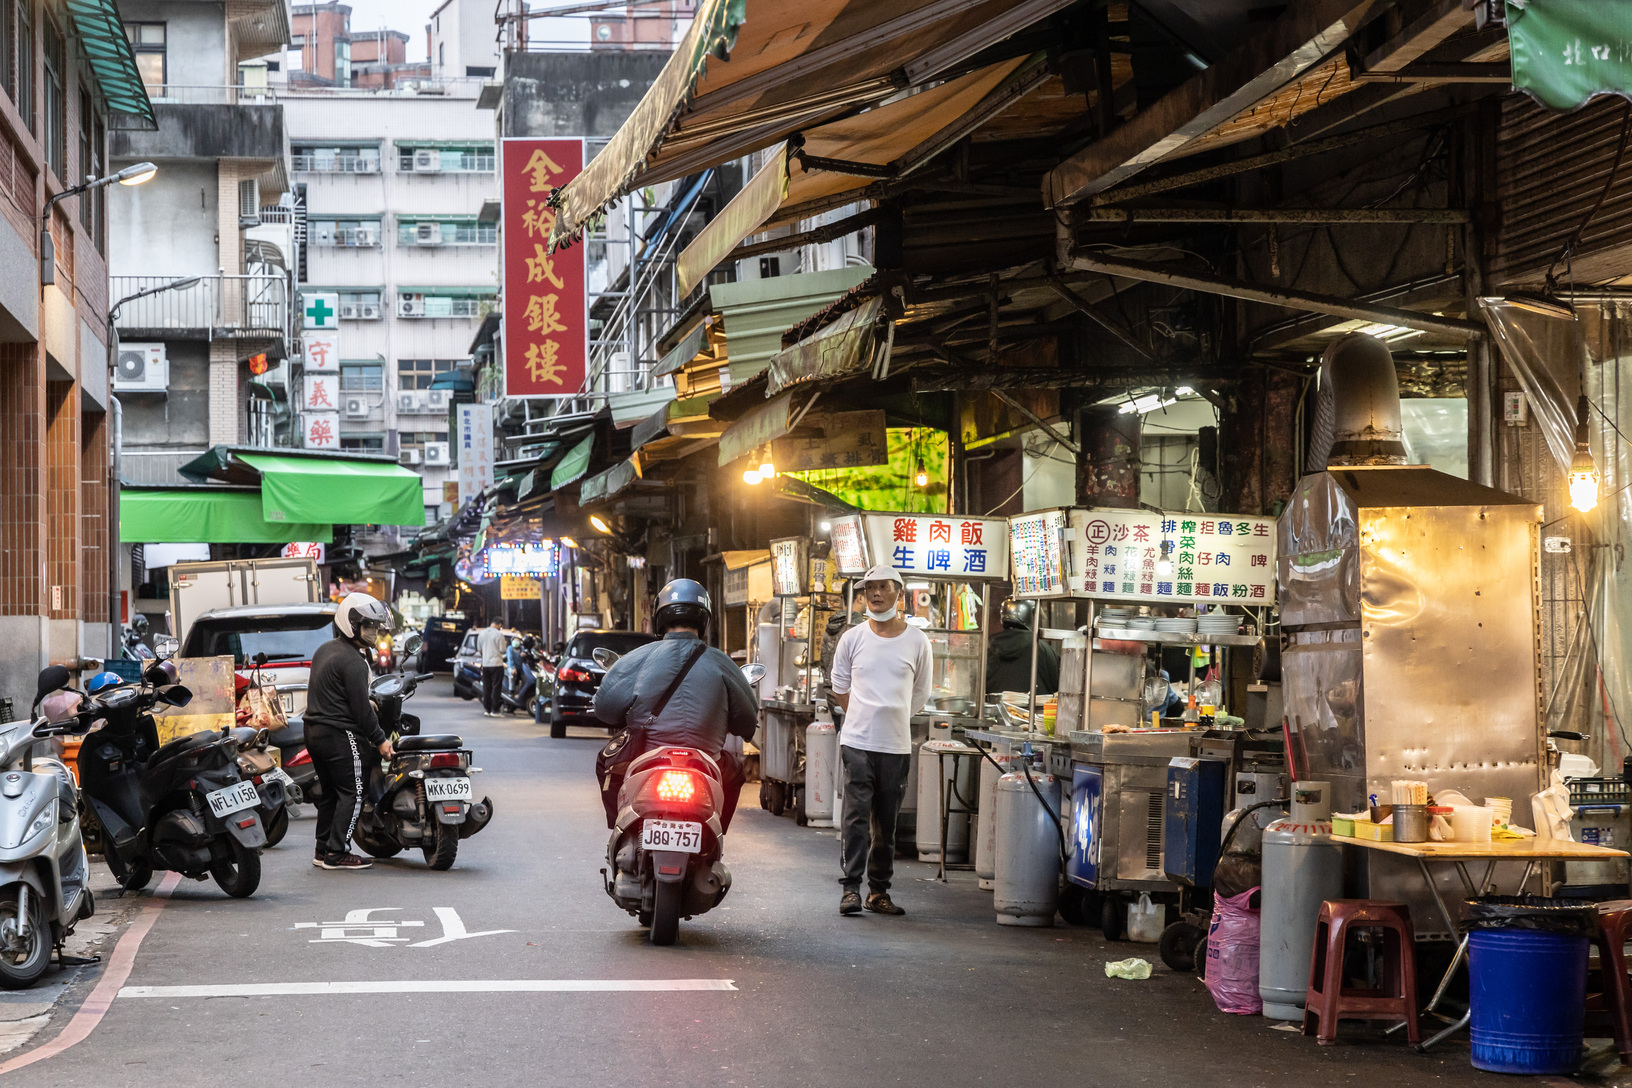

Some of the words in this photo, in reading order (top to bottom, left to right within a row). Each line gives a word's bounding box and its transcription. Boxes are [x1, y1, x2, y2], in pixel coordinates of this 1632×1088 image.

[521, 149, 568, 386] 金裕成銀樓
[308, 341, 333, 446] 守義藥
[892, 545, 987, 572] 生啤酒
[893, 518, 983, 545] 雞肉飯
[1157, 519, 1177, 595] 排骨麵
[1177, 520, 1196, 596] 榨菜肉絲麵
[1212, 521, 1233, 597] 魯肉飯
[1249, 523, 1270, 598] 生啤酒
